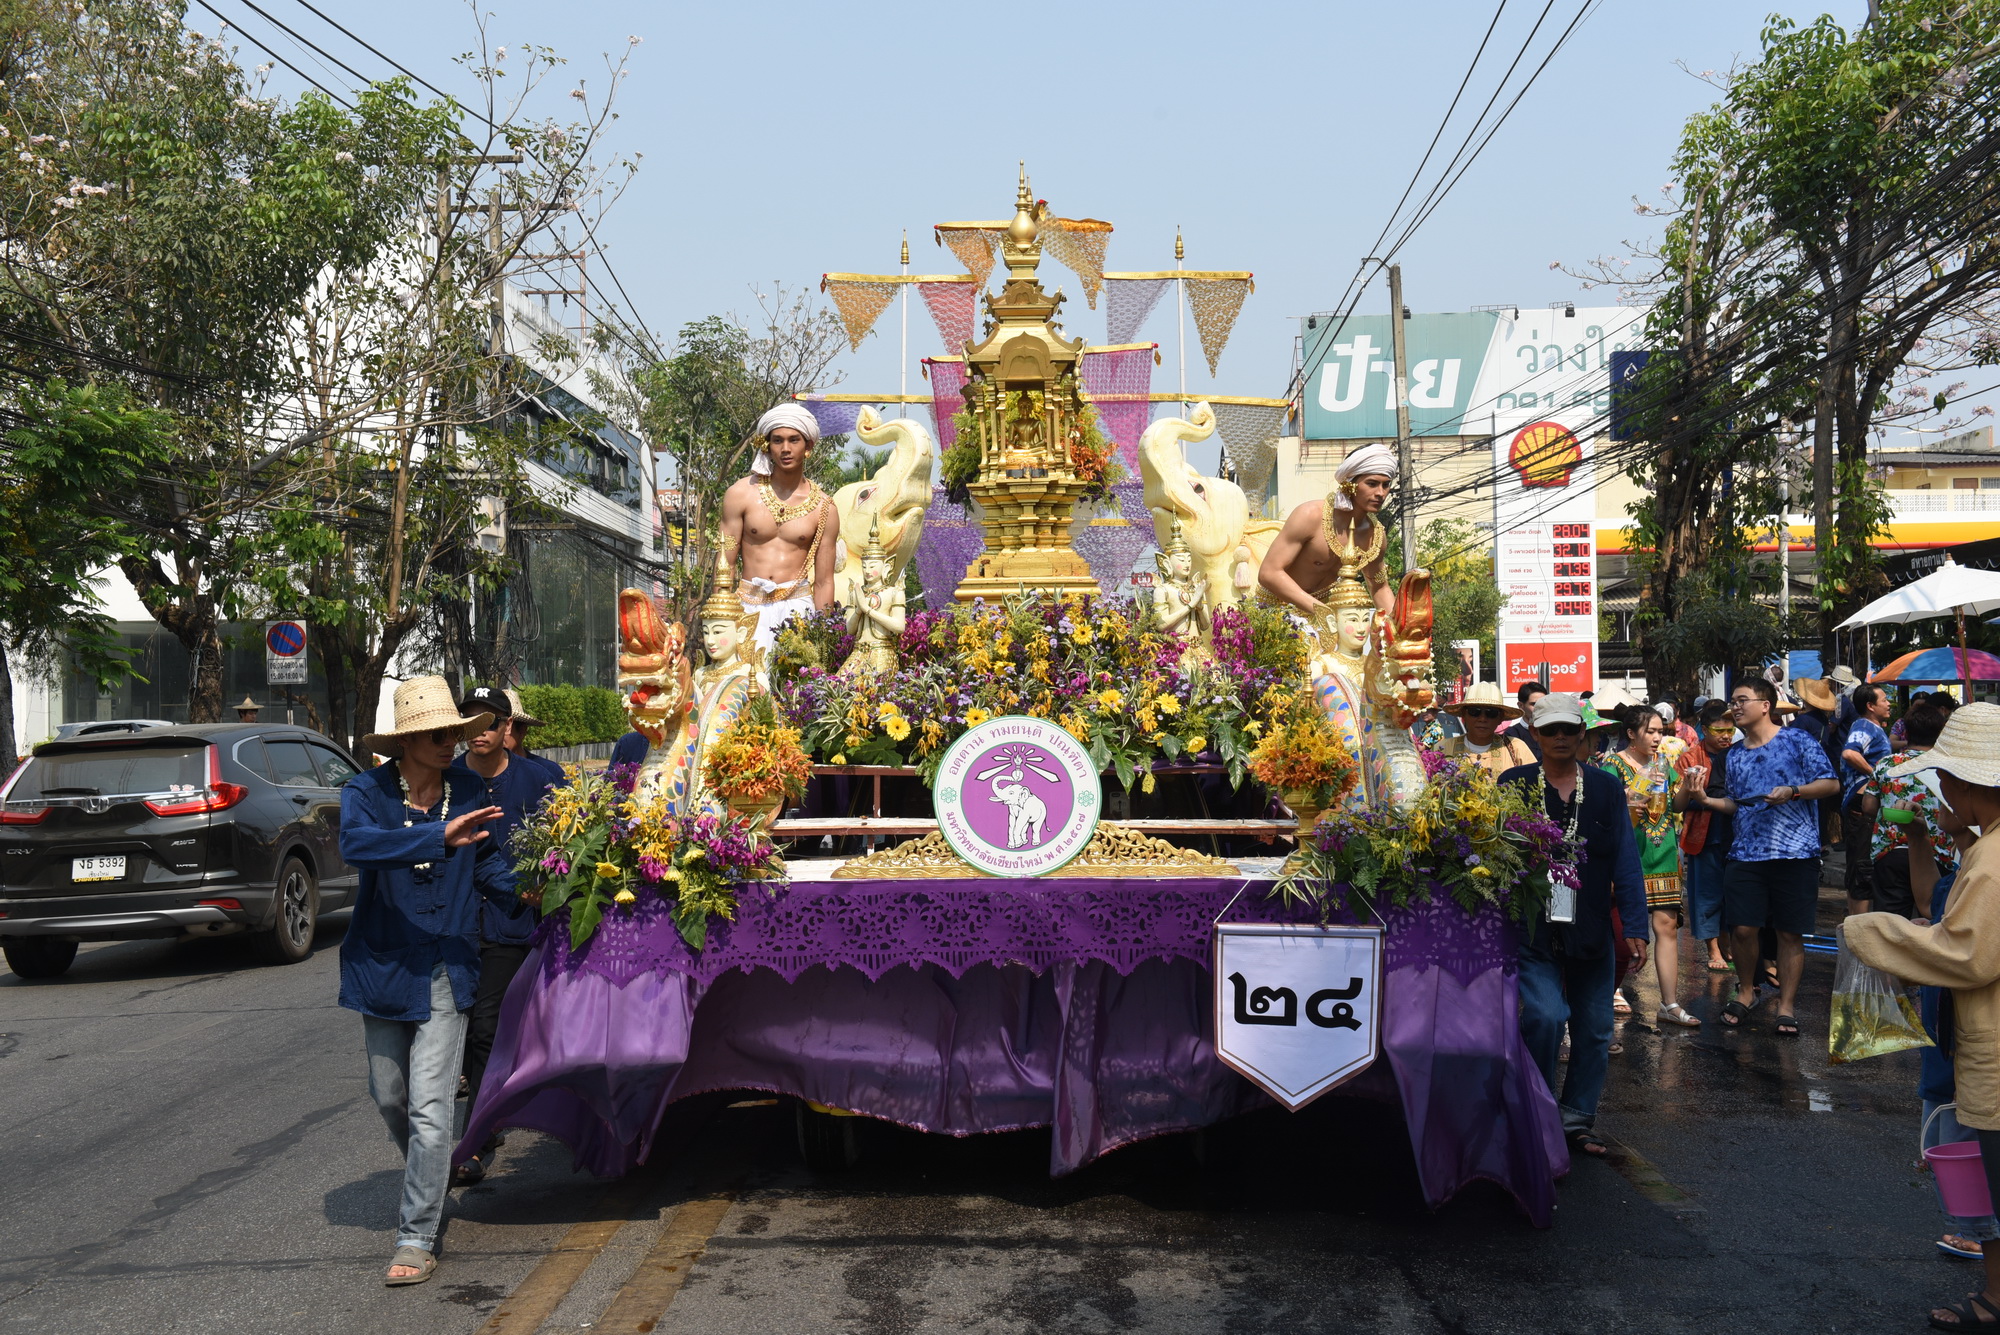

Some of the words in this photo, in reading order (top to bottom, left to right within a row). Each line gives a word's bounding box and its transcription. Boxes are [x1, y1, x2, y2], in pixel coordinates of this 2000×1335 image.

[1318, 334, 1461, 412] ป้าย
[1553, 524, 1590, 538] 28.04
[1553, 543, 1590, 557] 32.10
[1554, 562, 1591, 577] 27.39
[1554, 582, 1591, 596] 29.73
[1555, 601, 1592, 615] 34.48
[1511, 660, 1578, 675] วี-เพเวอร์
[170, 838, 197, 847] AWD
[946, 811, 1043, 869] มหาวิทยาลัยเชียงใหม่
[98, 857, 125, 869] 5392
[1227, 971, 1364, 1032] ๒๔
